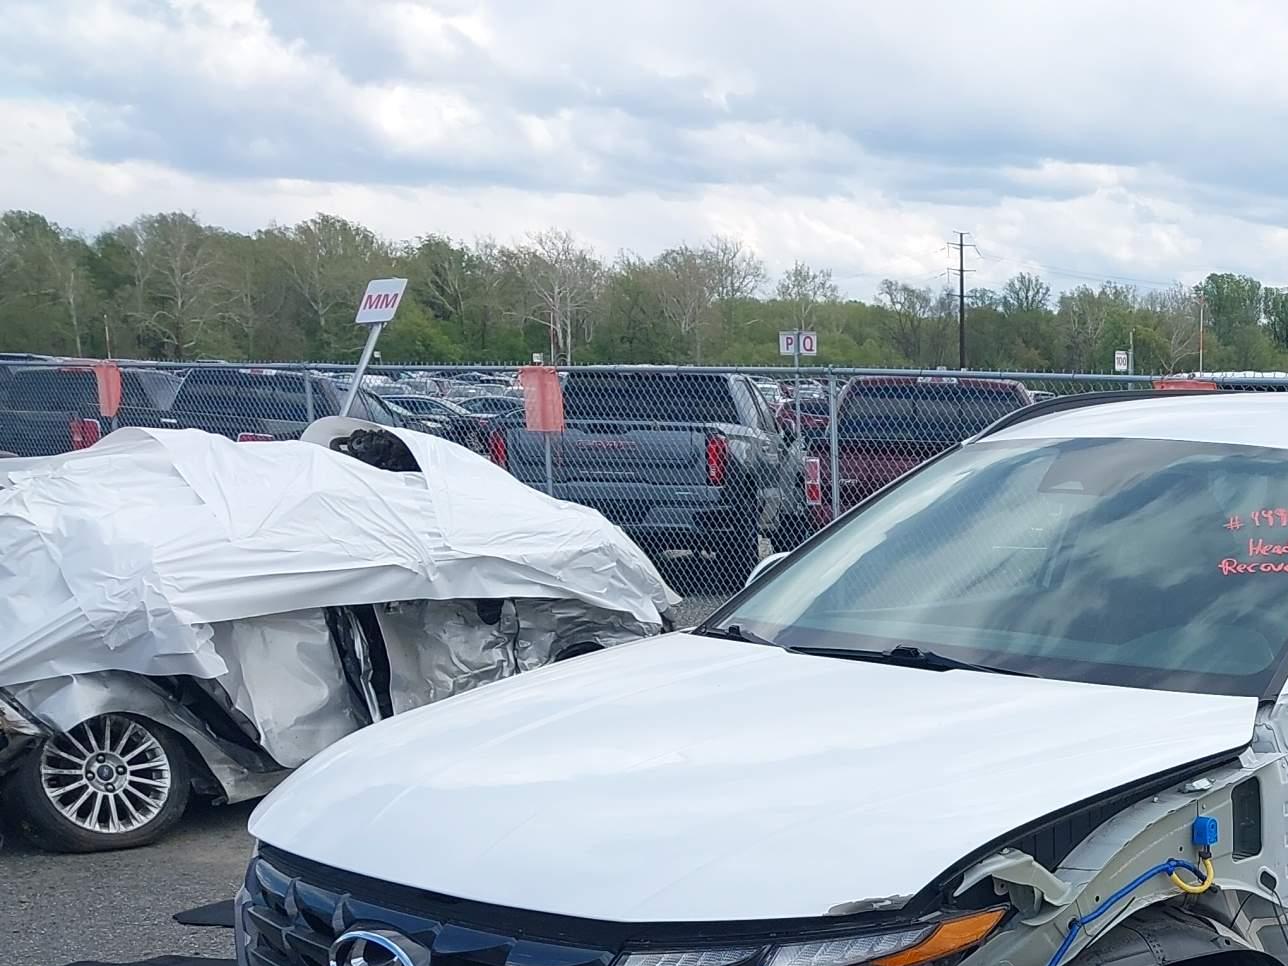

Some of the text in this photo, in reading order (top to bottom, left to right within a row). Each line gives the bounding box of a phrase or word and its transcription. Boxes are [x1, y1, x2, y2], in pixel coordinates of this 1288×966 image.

[362, 293, 399, 310] MM
[785, 336, 794, 351] P
[803, 335, 815, 352] Q
